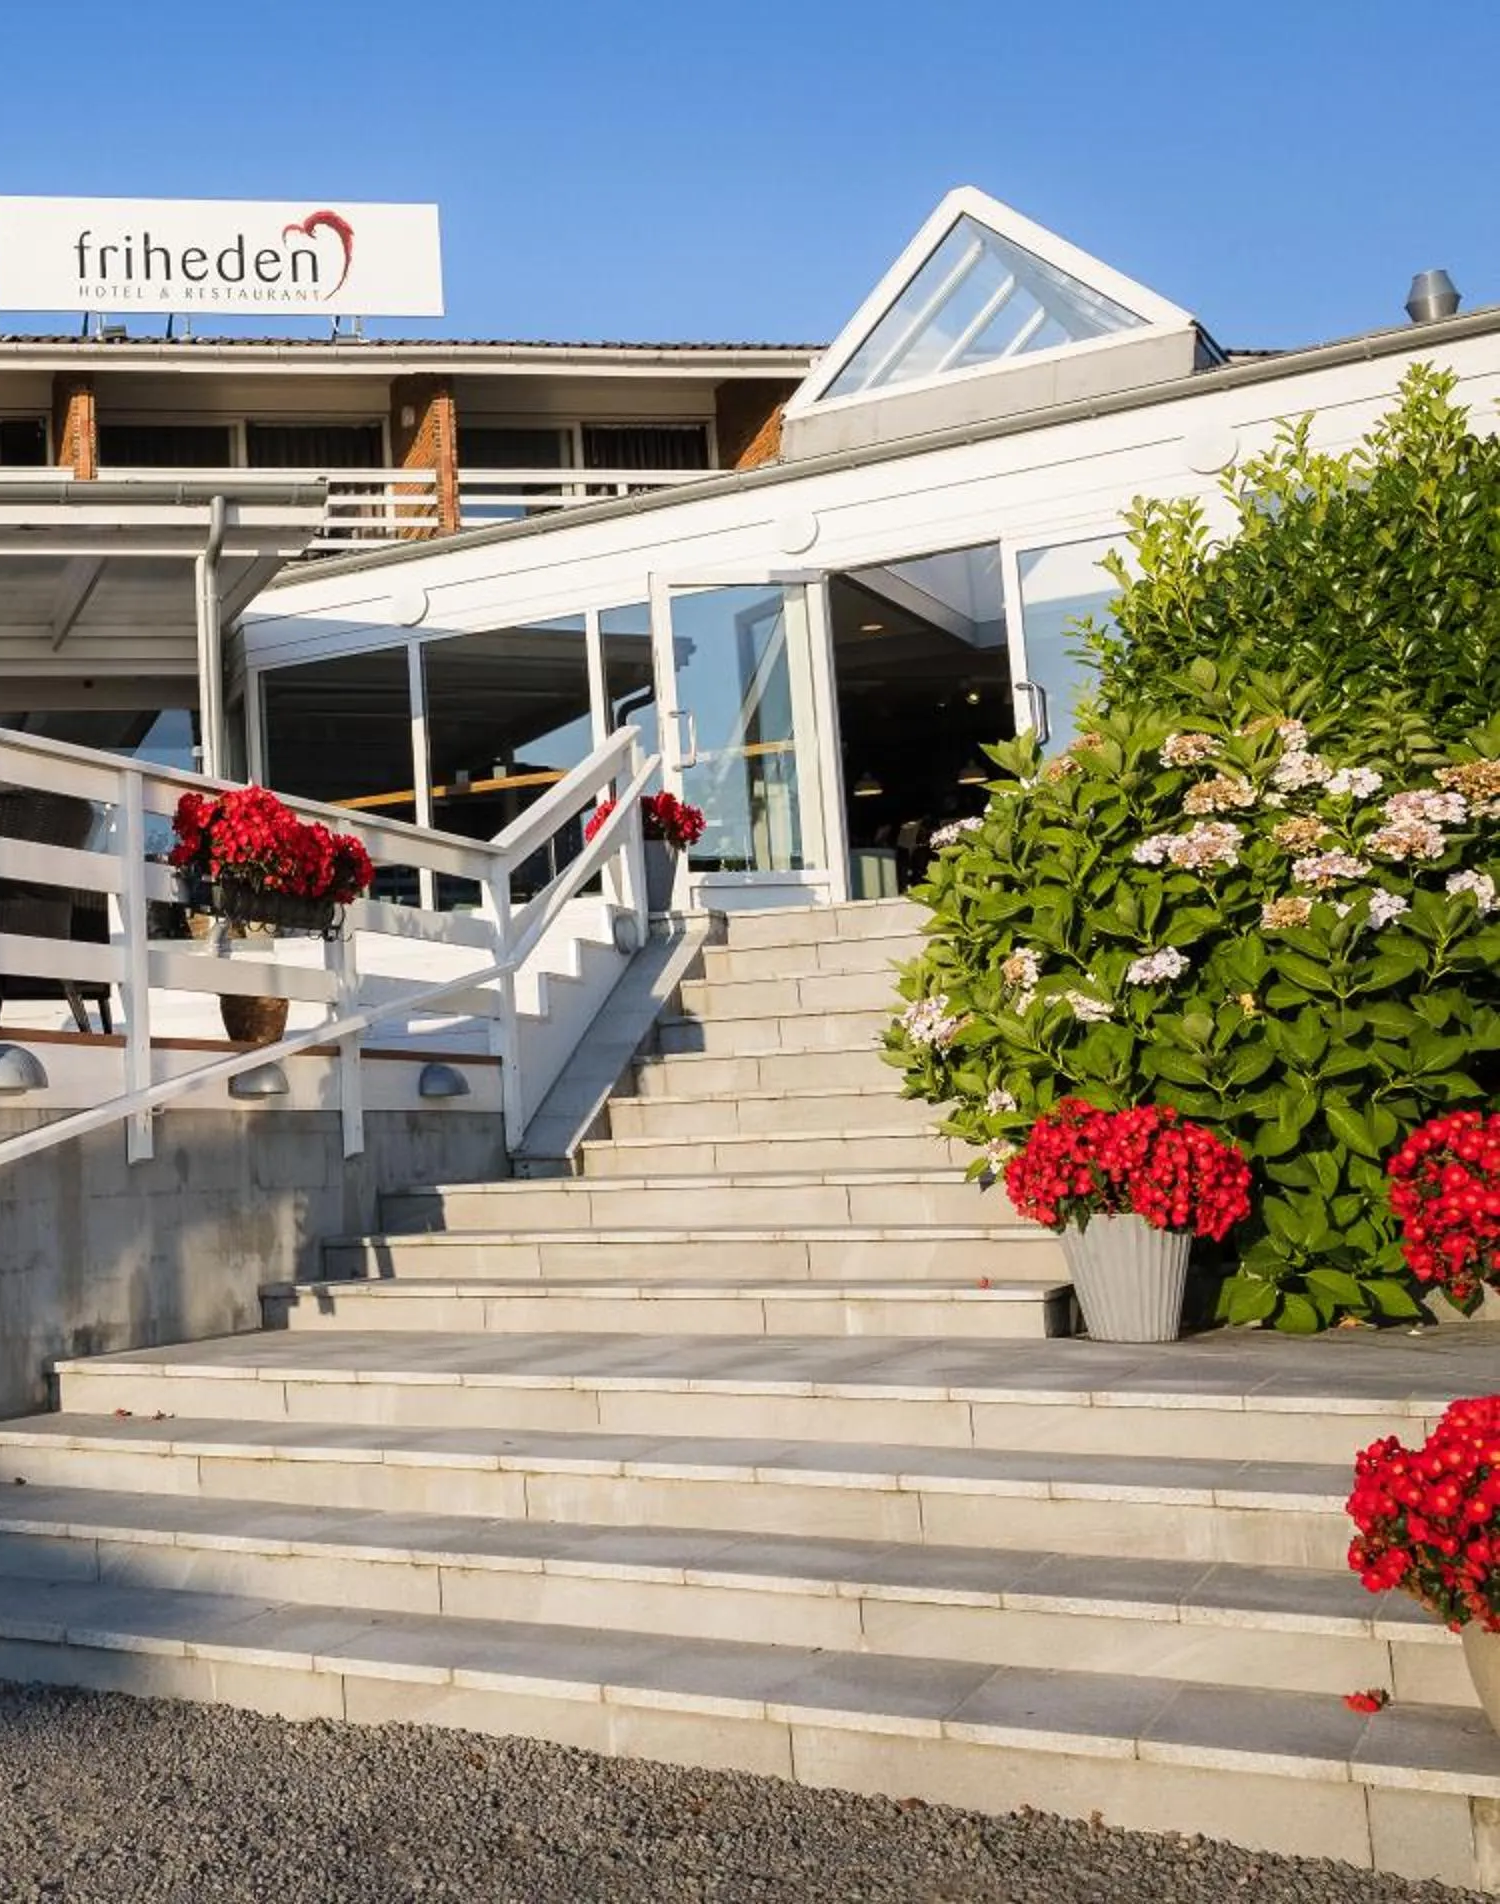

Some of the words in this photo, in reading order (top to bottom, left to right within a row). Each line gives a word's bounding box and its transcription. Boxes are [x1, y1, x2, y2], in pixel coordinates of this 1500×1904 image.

[73, 230, 319, 283] friheden
[78, 286, 144, 299] HOTEL
[159, 287, 170, 300] &
[184, 287, 321, 301] RESTAURANT
